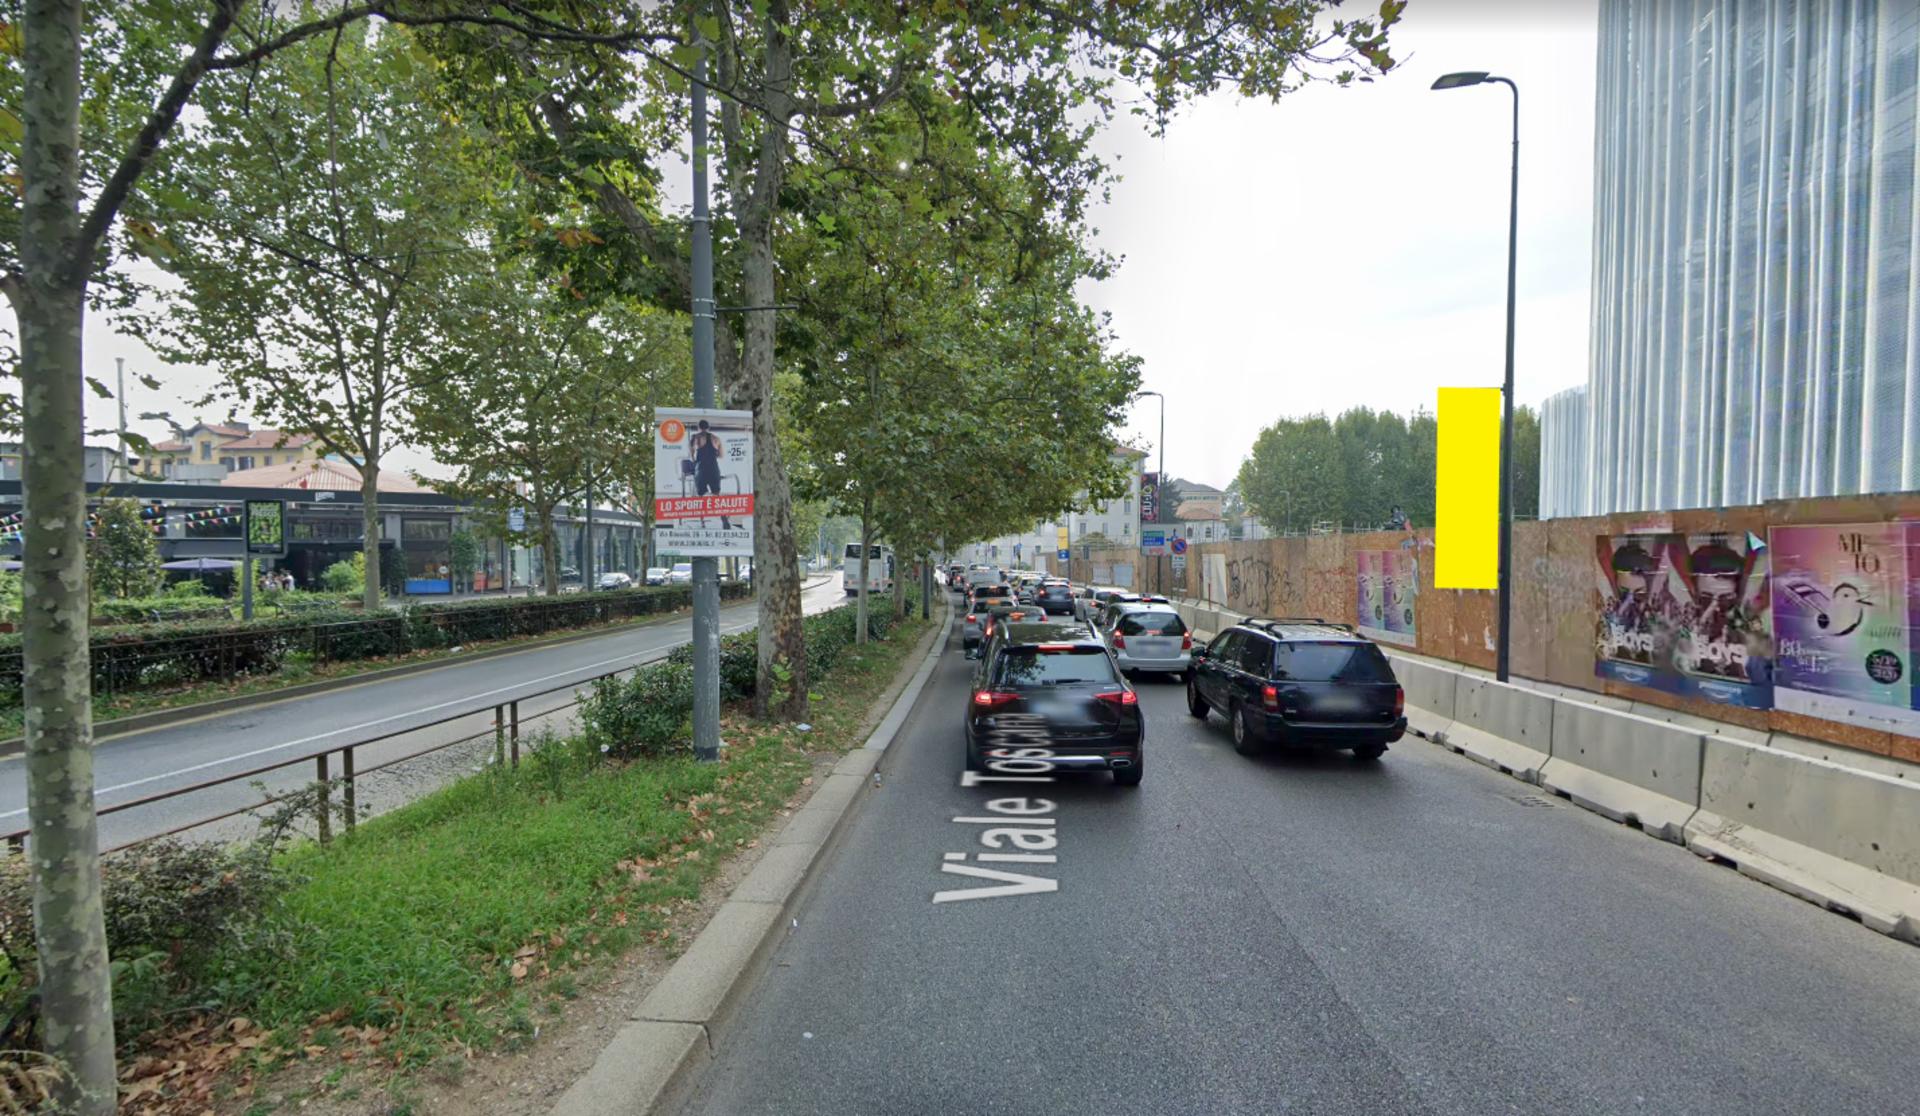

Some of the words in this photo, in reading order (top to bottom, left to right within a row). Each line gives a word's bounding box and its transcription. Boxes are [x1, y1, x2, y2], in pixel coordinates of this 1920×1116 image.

[660, 500, 672, 512] LO
[674, 499, 704, 511] SPORT
[706, 497, 713, 509] È
[714, 497, 749, 509] SALUTE
[1614, 631, 1654, 652] BOYS
[1699, 636, 1748, 665] BOYS
